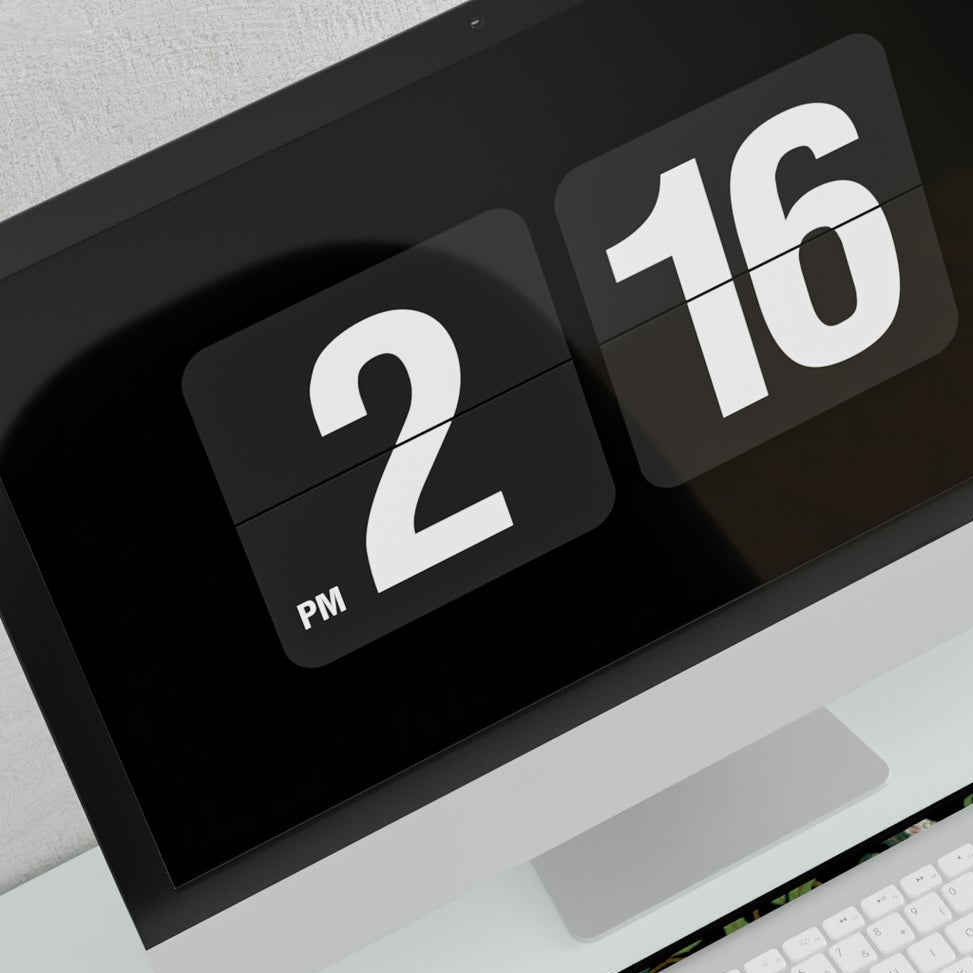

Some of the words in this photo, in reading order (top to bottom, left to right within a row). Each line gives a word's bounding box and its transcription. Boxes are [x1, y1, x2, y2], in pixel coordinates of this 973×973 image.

[310, 309, 513, 598] 2
[606, 103, 900, 418] 16
[297, 586, 346, 630] PM
